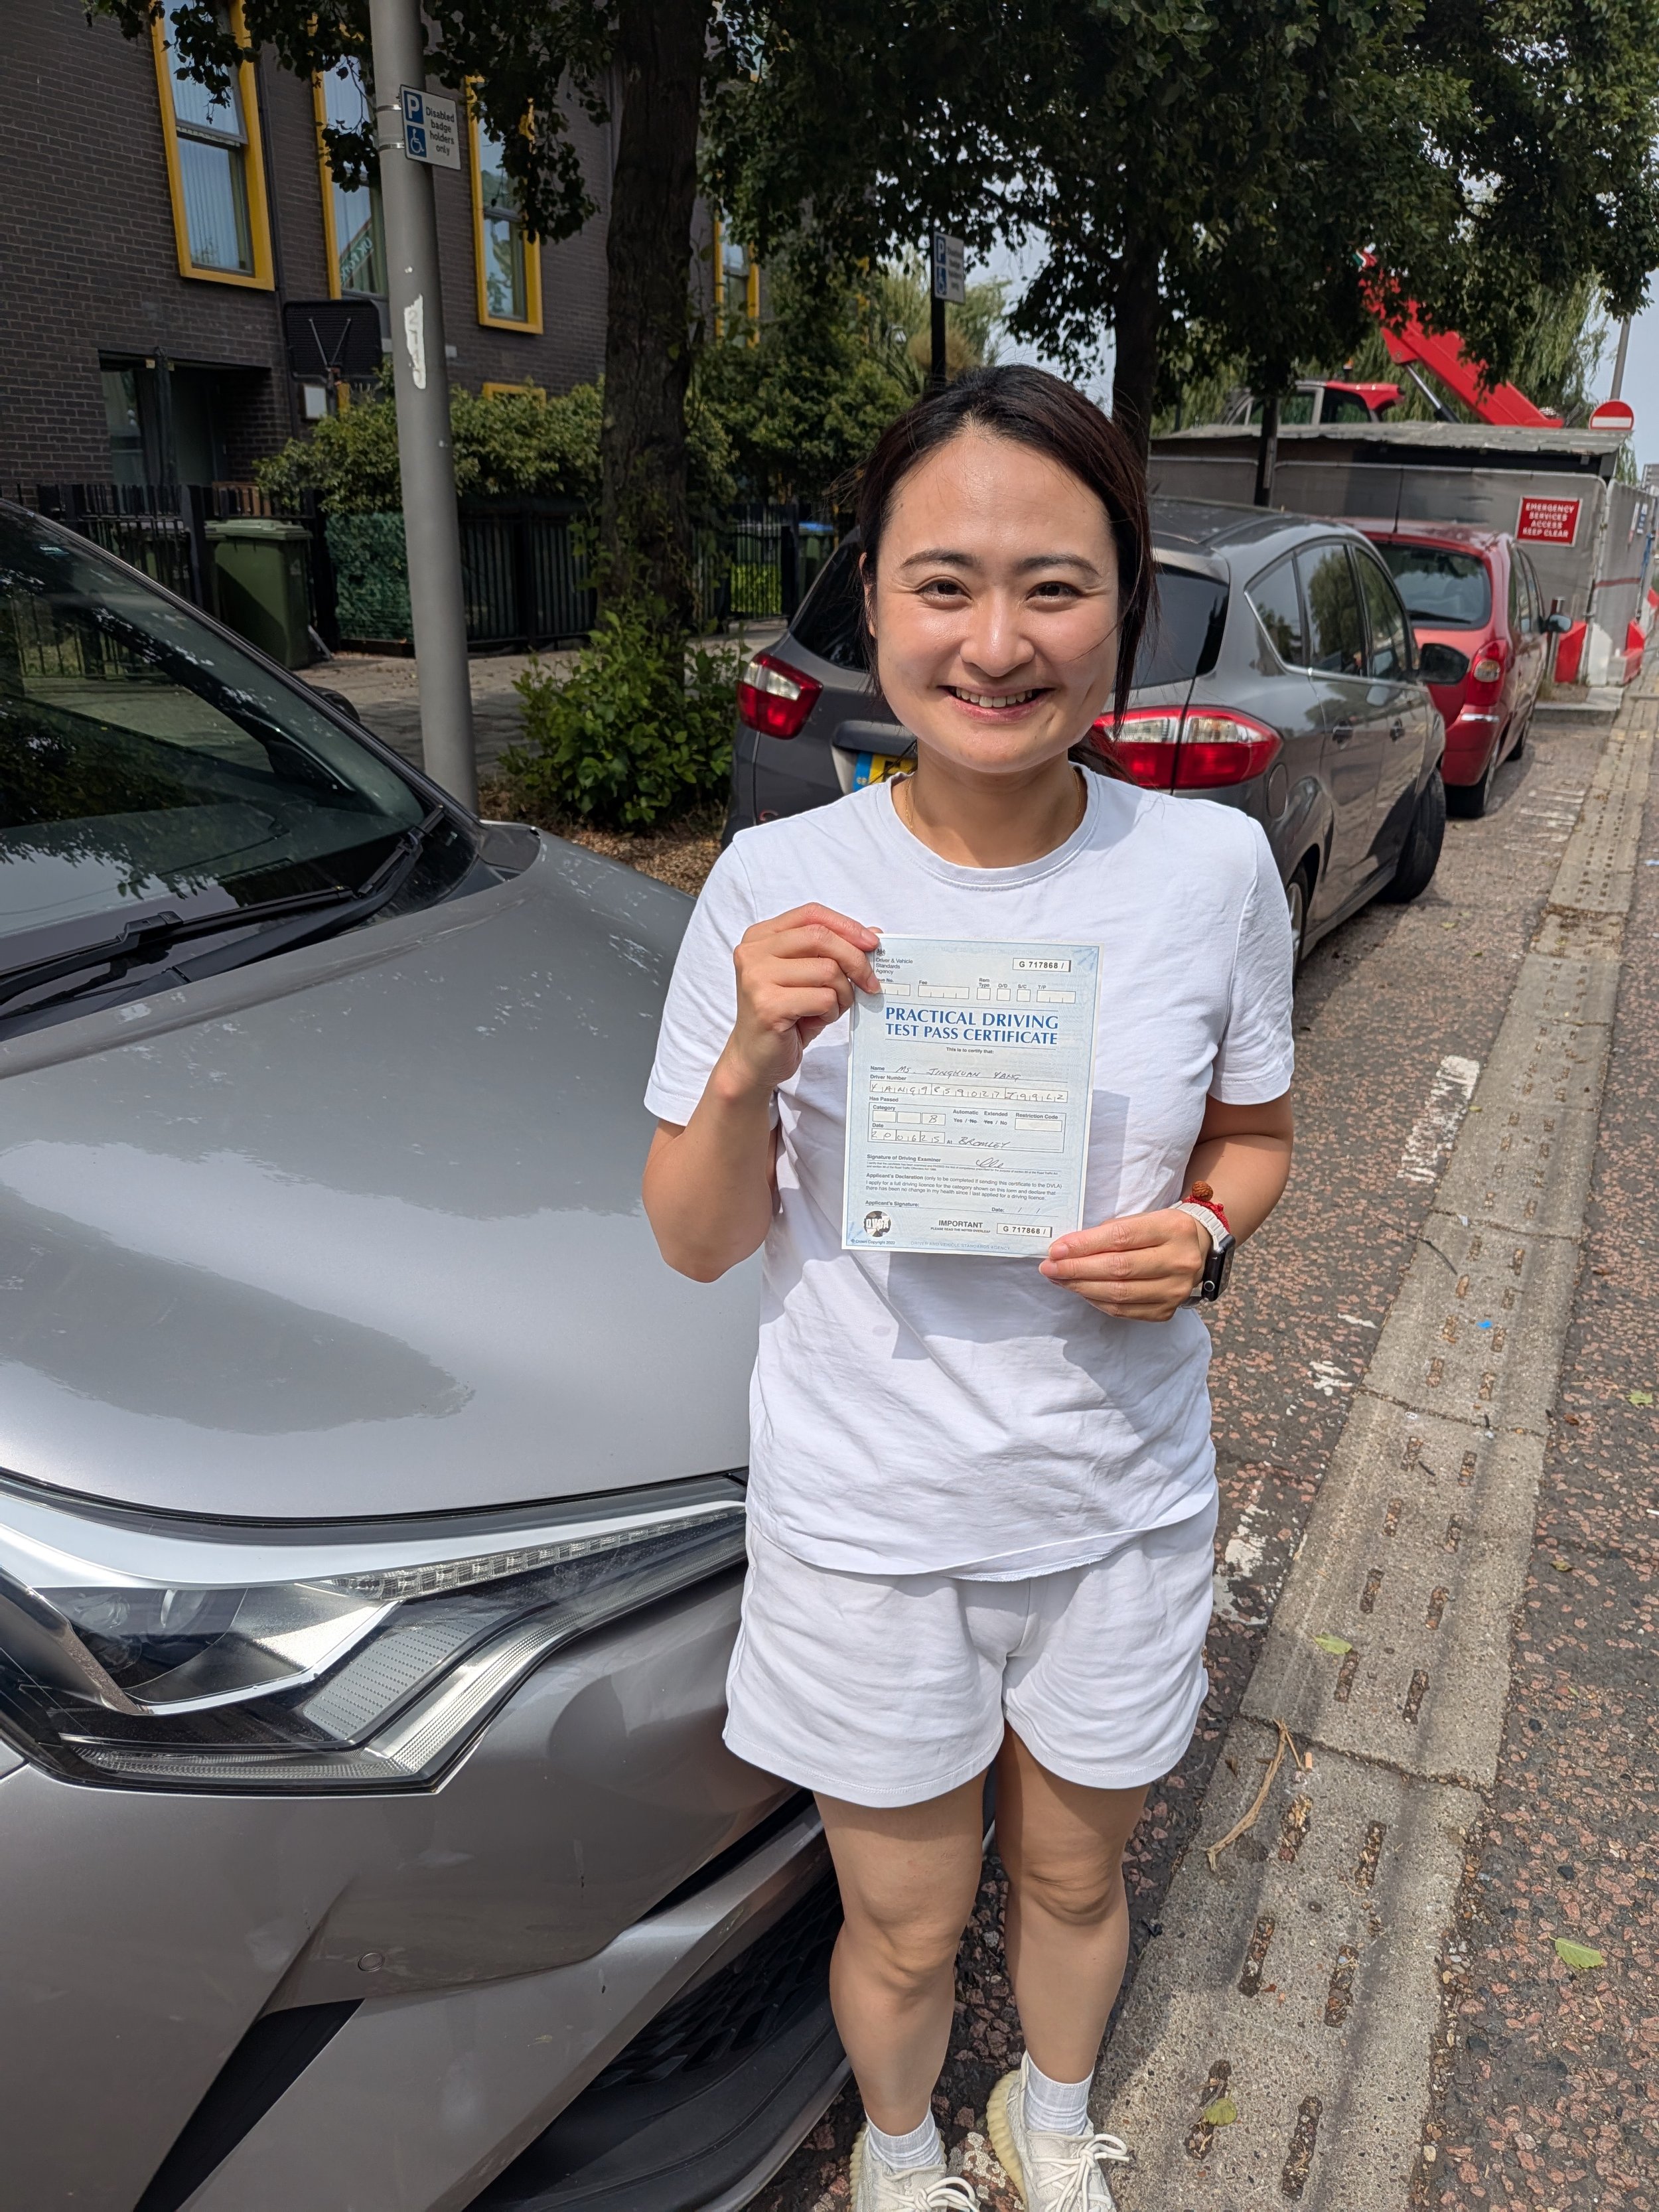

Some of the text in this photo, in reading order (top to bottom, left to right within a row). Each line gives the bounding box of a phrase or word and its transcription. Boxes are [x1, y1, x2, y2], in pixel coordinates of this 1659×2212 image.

[407, 94, 420, 119] P
[425, 106, 455, 123] Disabled
[431, 119, 451, 133] badge
[429, 131, 455, 145] holders
[436, 145, 450, 156] only
[1526, 502, 1575, 514] EMERGENCY
[1529, 511, 1568, 522] SERVICES
[1530, 520, 1563, 529] ACCESS
[1522, 527, 1569, 538] KEEP CLEAR
[885, 1007, 1058, 1029] PRACTICAL DRIVING
[885, 1023, 1058, 1045] TEST PASS CERTIFICATE
[993, 1071, 1021, 1082] YANG
[865, 1218, 889, 1229] DVSA
[938, 1220, 983, 1228] IMPORTANT
